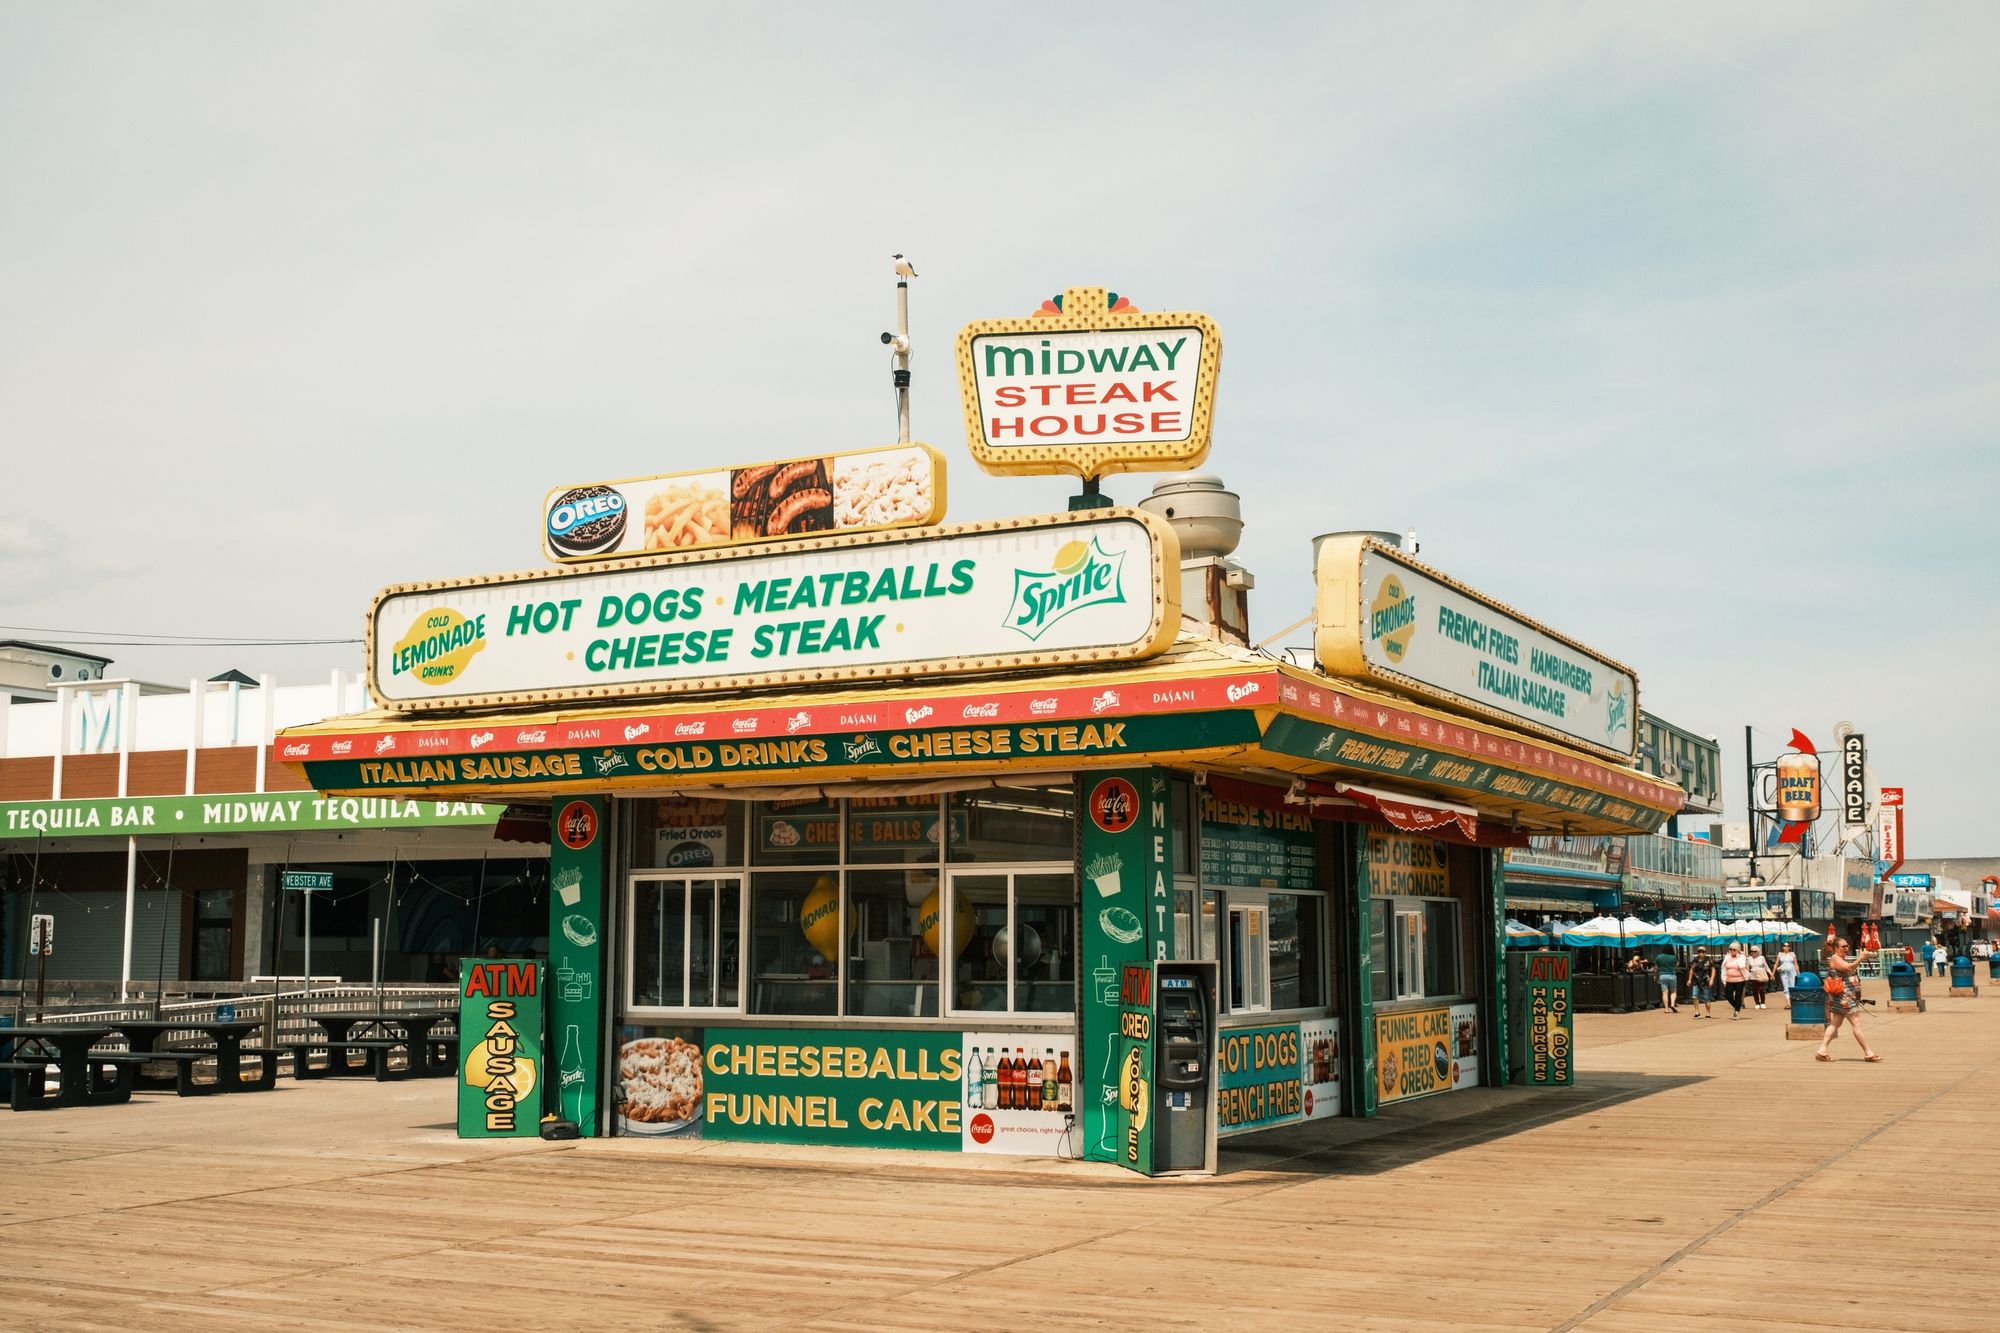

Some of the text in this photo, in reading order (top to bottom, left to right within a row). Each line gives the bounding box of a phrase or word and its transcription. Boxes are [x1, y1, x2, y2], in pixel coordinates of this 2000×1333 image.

[994, 381, 1178, 408] STEAK
[991, 412, 1182, 438] HOUSE
[550, 494, 624, 532] OREO
[506, 559, 977, 636] HOT DOGS MEATBALLS
[1015, 559, 1113, 627] Sprite
[427, 615, 449, 629] COLD
[1370, 595, 1415, 641] LEMONADE
[392, 614, 486, 676] LEMONADE
[585, 614, 886, 672] CHEESE STEAK
[1438, 605, 1592, 696] FRENCH FRIES HAMBURGERS
[422, 665, 454, 679] DRINKS
[1153, 690, 1195, 704] DASANI
[1227, 681, 1259, 703] Fanta
[1478, 660, 1565, 718] ITALIAN SAUSAGE
[905, 704, 933, 724] Fanta
[963, 703, 1000, 718] Coca-Cola
[1093, 693, 1119, 712] Sprite
[624, 722, 650, 741] Fanta
[674, 721, 707, 736] Coca-Cola
[840, 714, 877, 726] DASANI
[418, 737, 449, 748] DASANI
[470, 732, 494, 749] Fanta
[567, 728, 600, 740] DASANI
[888, 722, 1127, 758] CHEESE STEAK
[597, 752, 624, 773] Sprite
[636, 740, 828, 771] COLD DRINKS
[847, 738, 878, 761] Sprite
[1336, 738, 1384, 765] FRENCH
[1379, 748, 1411, 770] FRIES
[360, 753, 583, 784] ITALIAN SAUSAGE
[1846, 737, 1863, 821] ARCADE
[1781, 777, 1815, 789] DRAFT
[1784, 791, 1812, 802] BEER
[7, 806, 155, 832] TEQUILA BAR
[203, 798, 486, 824] MIDWAY TEQUILA BAR
[659, 828, 722, 840] Fried Oreos
[873, 819, 921, 841] BALLS
[1884, 825, 1893, 860] PIZZA
[669, 848, 712, 866] OREO
[1393, 841, 1432, 867] OREOS
[319, 874, 333, 887] AVE
[1384, 871, 1445, 897] LEMONADE
[1899, 875, 1926, 886] SE7EN
[465, 963, 537, 998] ATM
[1530, 955, 1568, 982] ATM
[1121, 966, 1150, 1006] ATM
[1167, 979, 1188, 988] ATM
[1552, 988, 1567, 1022] HOT
[1121, 1012, 1150, 1040] OREO
[1379, 1012, 1449, 1044] FUNNEL CAKE
[1532, 987, 1547, 1081] HAMBURGERS
[706, 1043, 962, 1081] CHEESEBALLS
[1254, 1030, 1297, 1069] DOGS
[1402, 1044, 1430, 1070] FRIED
[1554, 1034, 1567, 1081] DOGS
[484, 1001, 517, 1131] SAUSAGE
[561, 1069, 583, 1086] Sprite
[1400, 1067, 1434, 1095] OREOS
[1128, 1047, 1140, 1161] COOKIES
[1268, 1079, 1300, 1117] FRIES
[706, 1092, 962, 1134] FUNNEL CAKE
[971, 1123, 993, 1134] Coca-Cola
